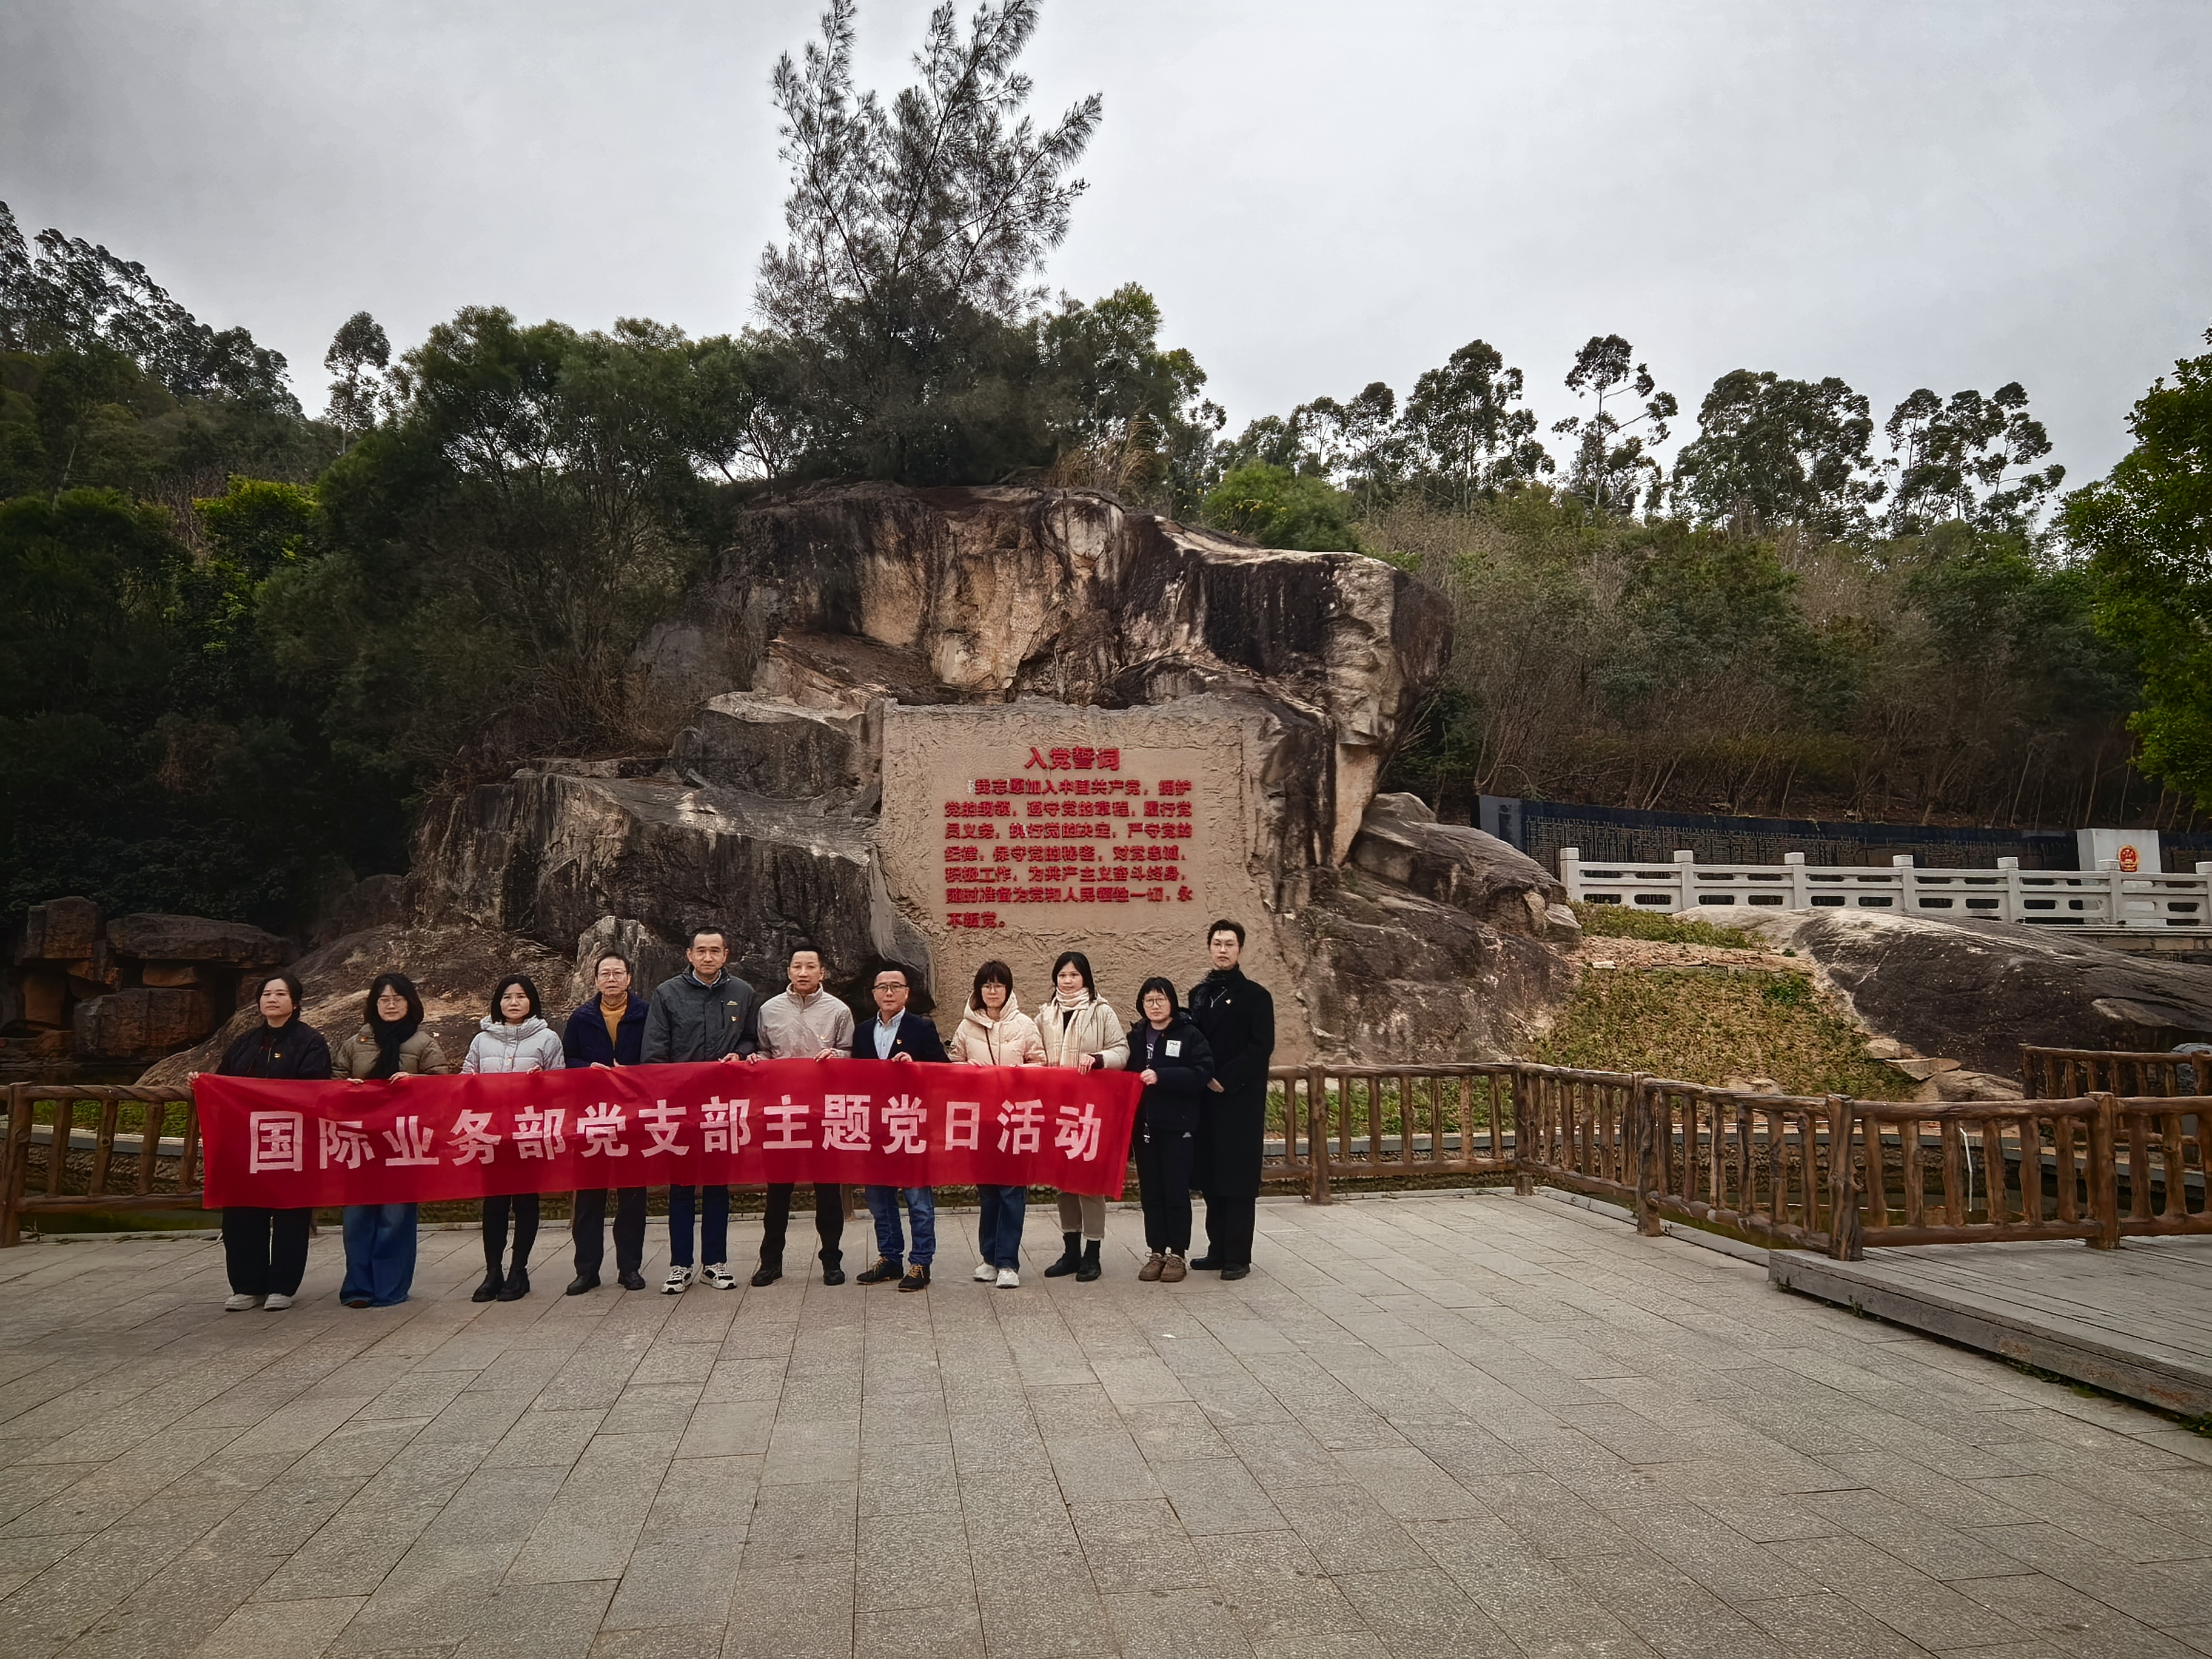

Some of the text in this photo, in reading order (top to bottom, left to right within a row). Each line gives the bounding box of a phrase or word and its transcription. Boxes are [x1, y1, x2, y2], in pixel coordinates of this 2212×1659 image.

[1024, 745, 1121, 772] 入党誓词
[249, 1094, 1102, 1174] 国际业务部党支部主题党日活动
